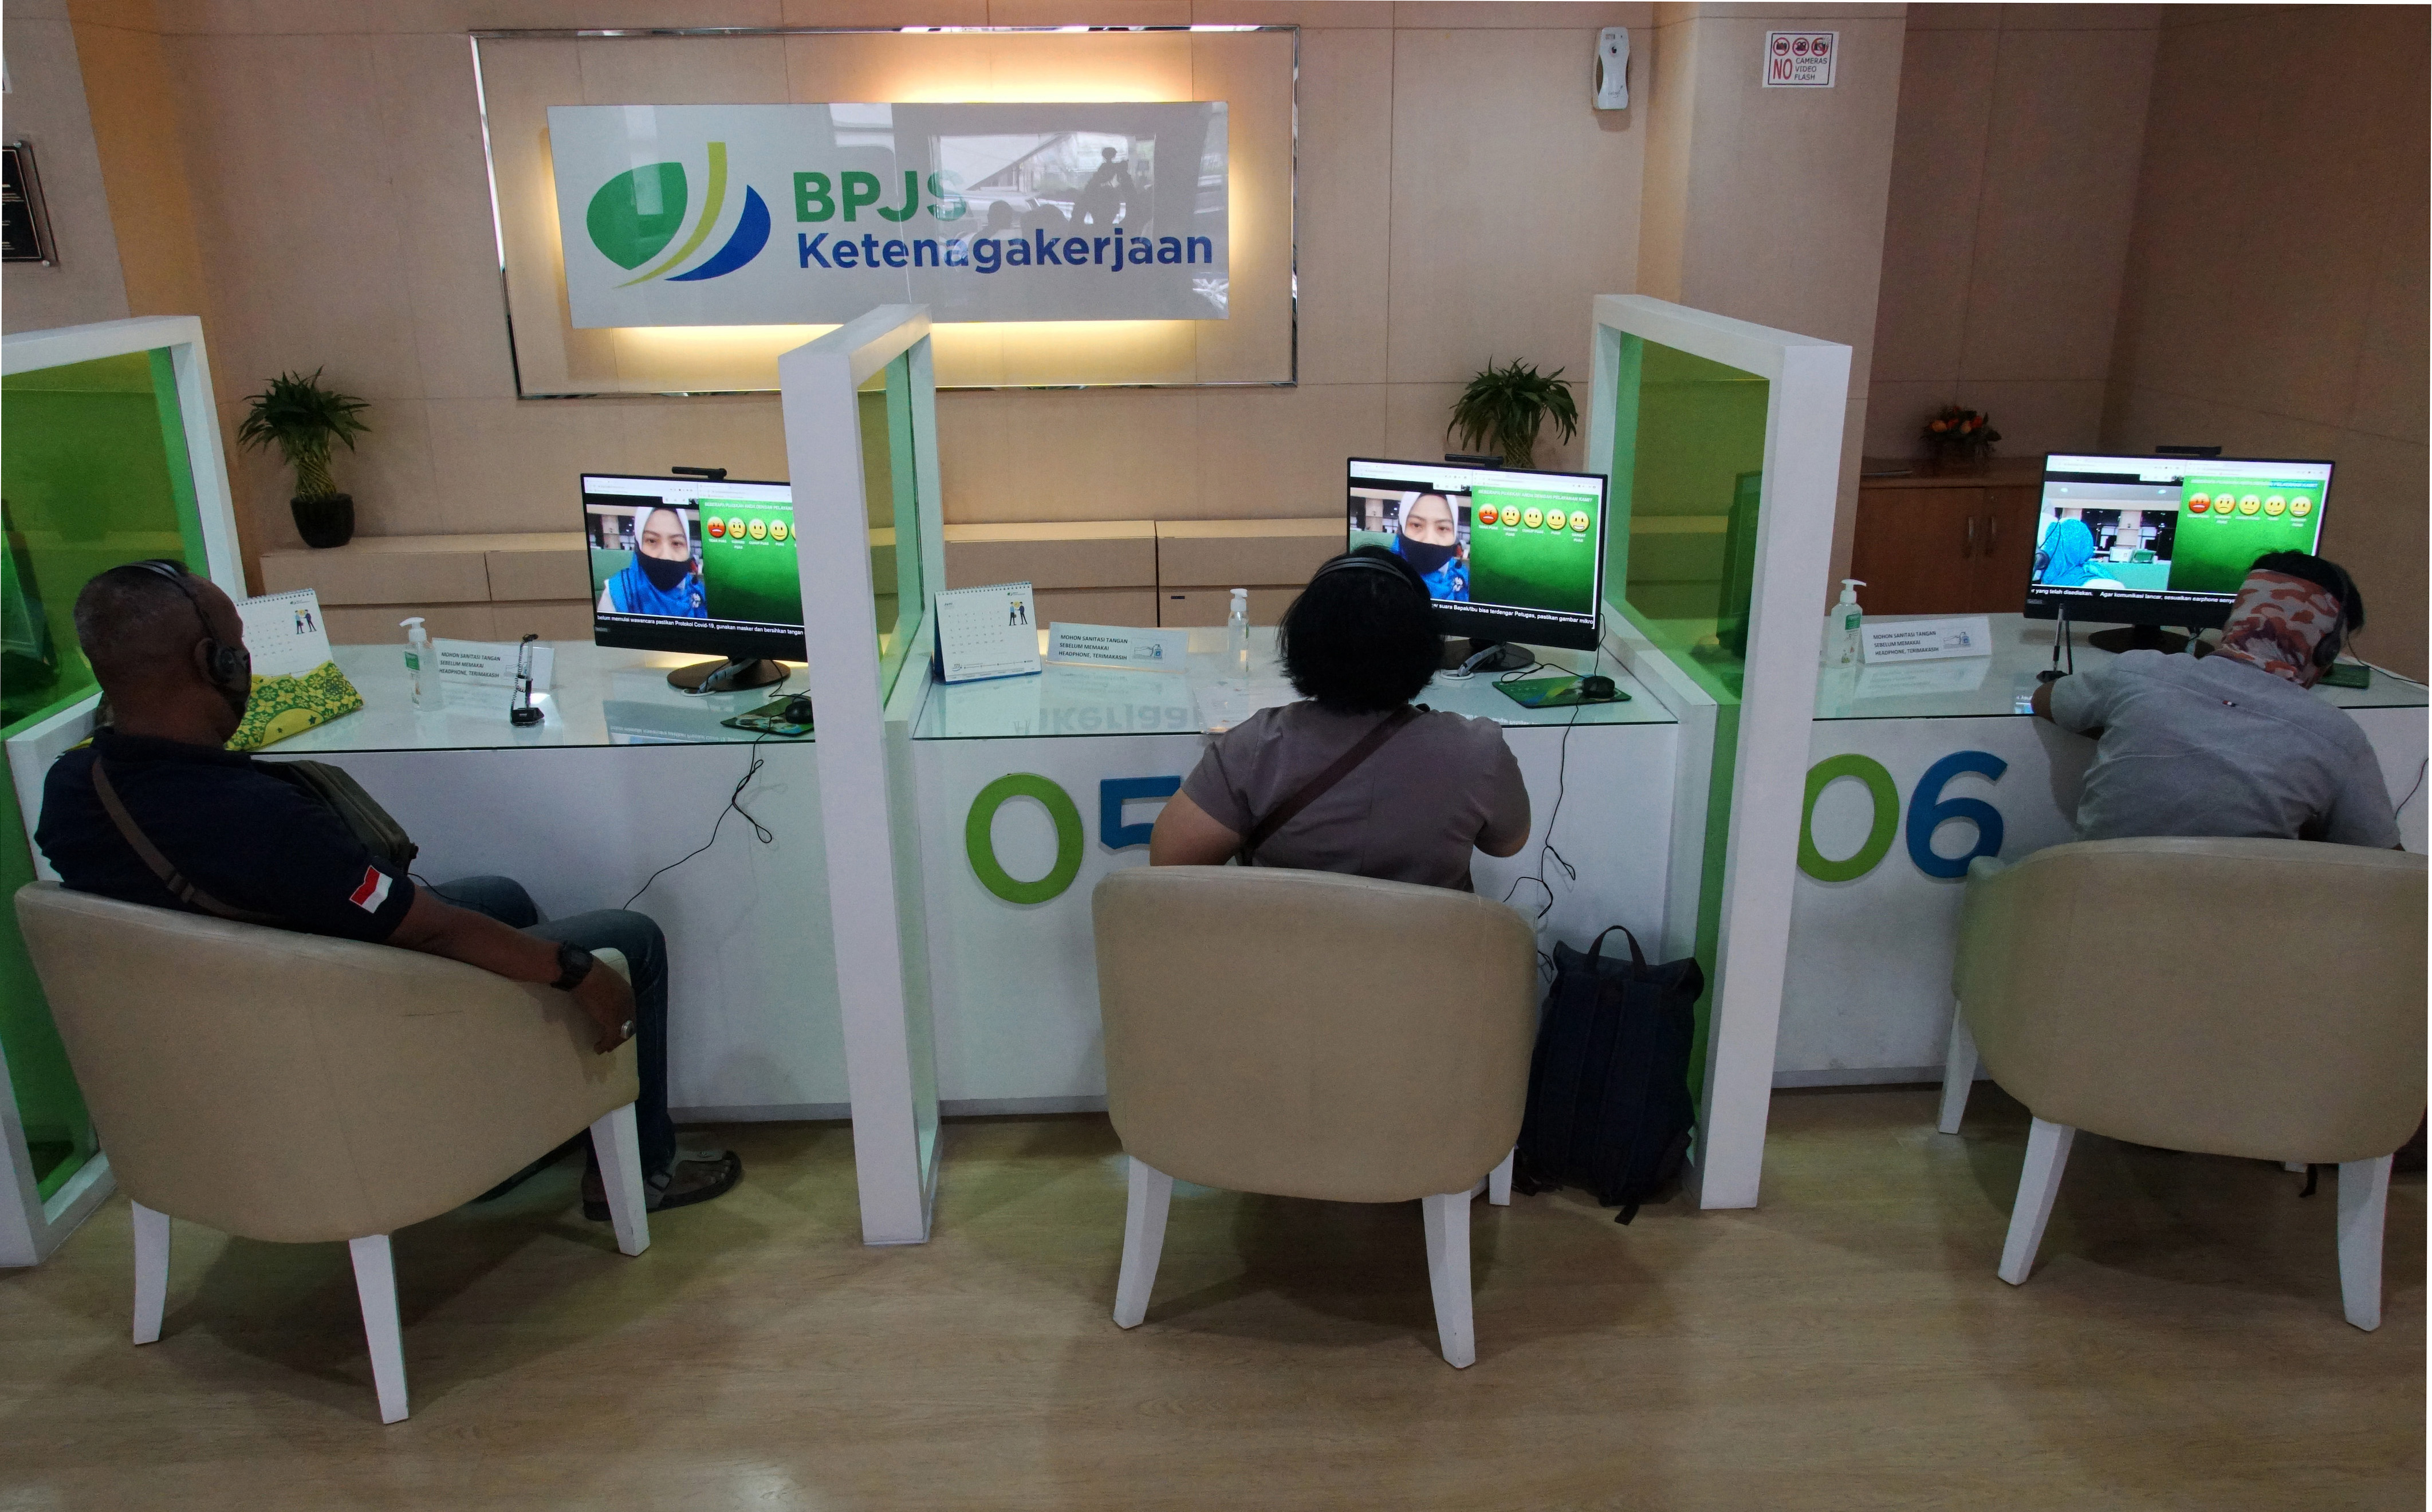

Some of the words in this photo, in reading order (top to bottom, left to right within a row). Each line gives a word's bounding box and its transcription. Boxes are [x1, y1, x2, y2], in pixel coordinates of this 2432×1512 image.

[1773, 58, 1792, 80] NO
[793, 170, 966, 224] BPJS
[797, 228, 1213, 274] Ketenagakerjaan
[1796, 750, 2008, 883] 06
